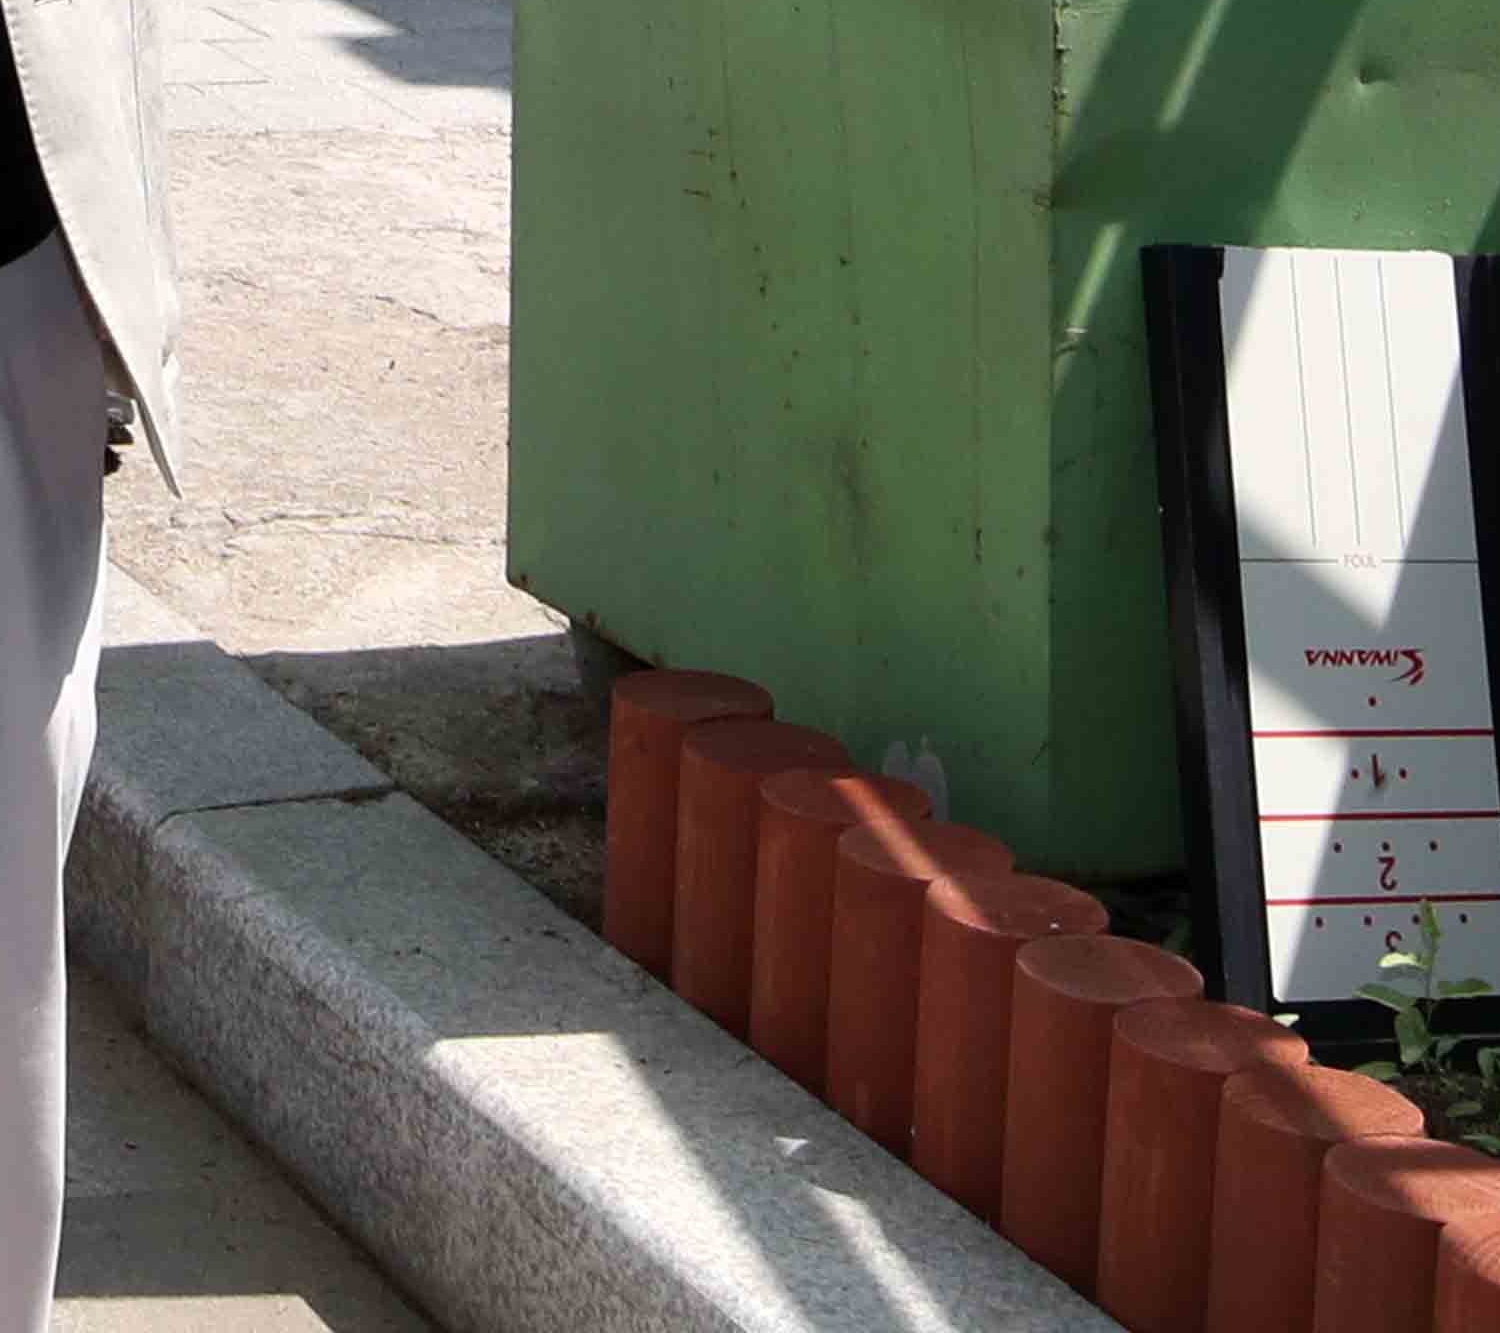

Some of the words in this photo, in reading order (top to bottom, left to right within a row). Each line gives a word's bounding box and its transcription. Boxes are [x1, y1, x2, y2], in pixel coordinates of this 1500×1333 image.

[1342, 553, 1379, 569] FOUL
[1371, 753, 1386, 788] 1
[1376, 855, 1398, 892] 2
